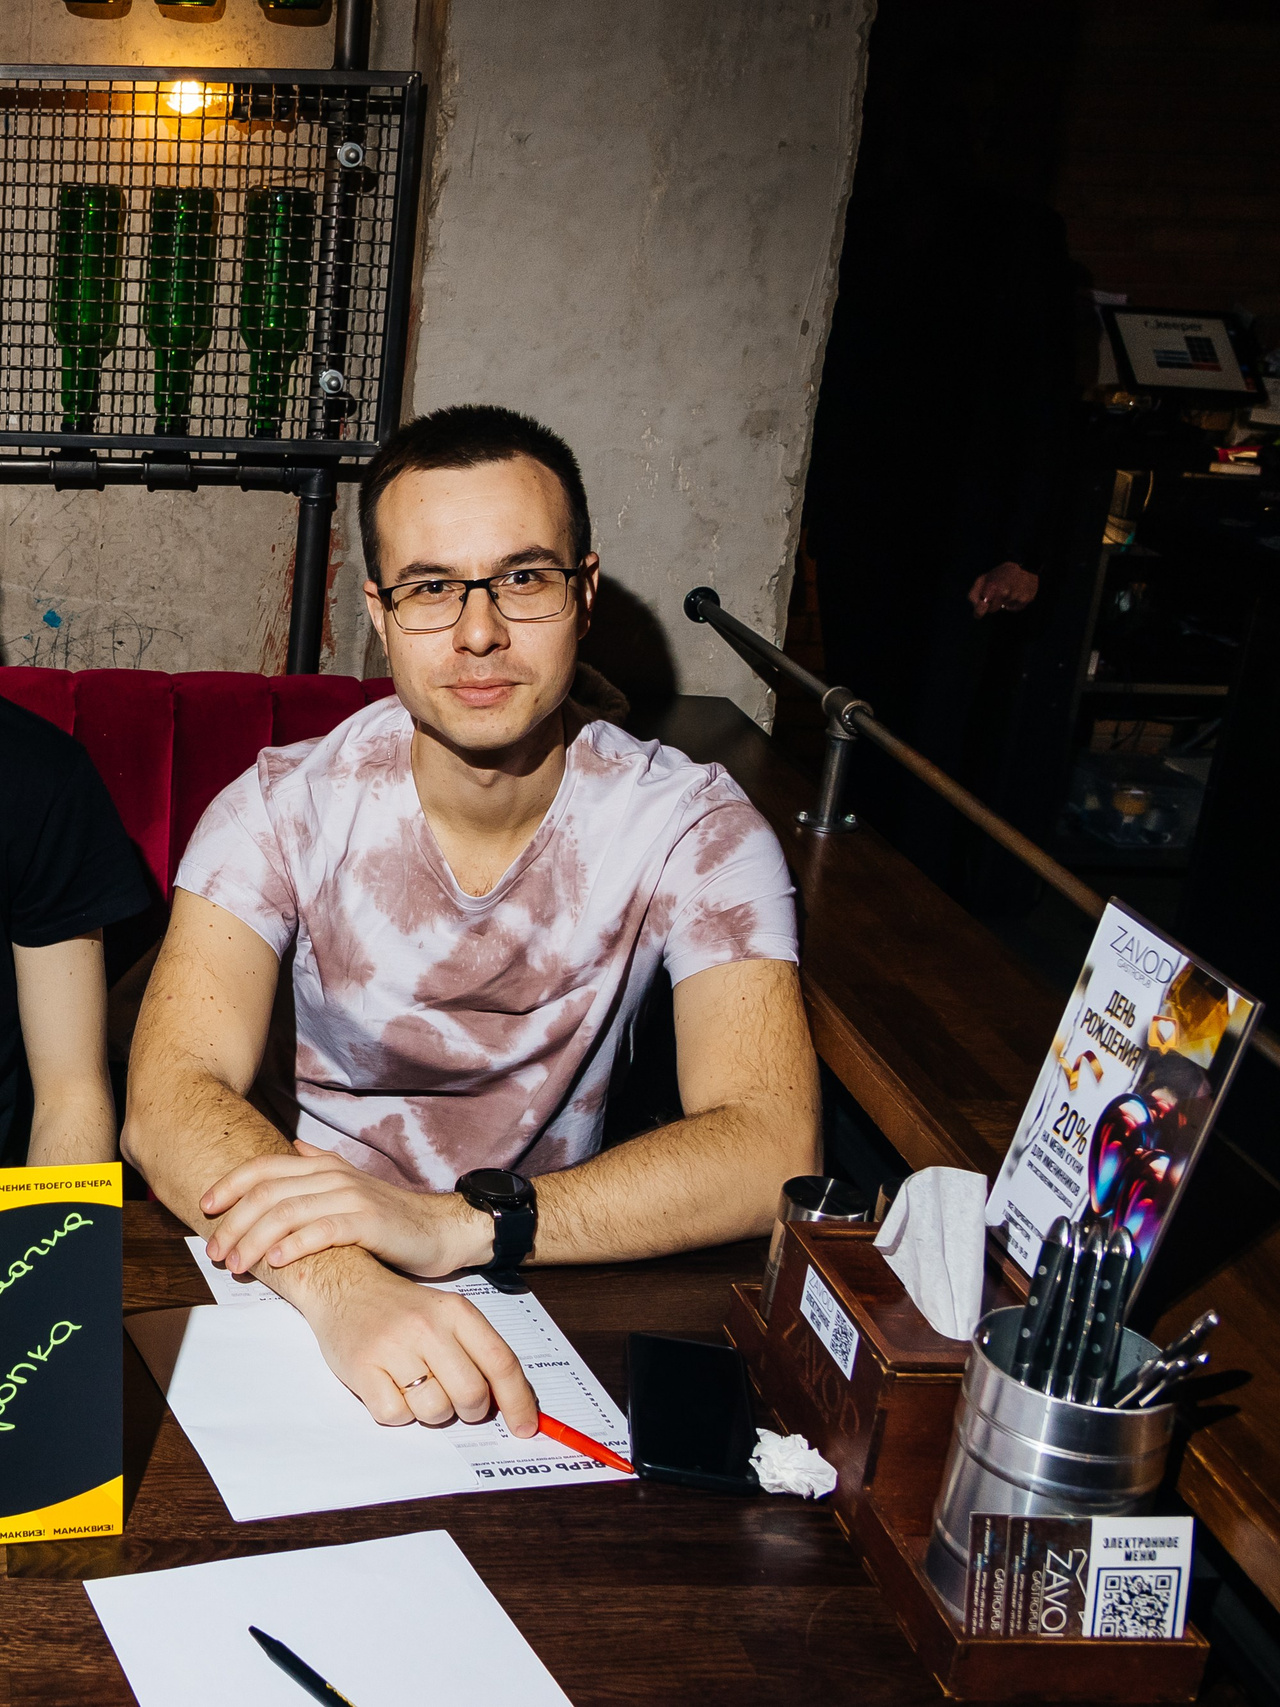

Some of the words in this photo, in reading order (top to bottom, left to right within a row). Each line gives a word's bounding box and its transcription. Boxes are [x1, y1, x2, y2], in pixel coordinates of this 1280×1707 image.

[1110, 926, 1175, 984] ZAVOD
[1104, 990, 1136, 1029] ДЕНЬ
[1080, 1008, 1142, 1071] РОЖДЕНИЯ
[1053, 1102, 1092, 1157] 20%
[33, 1180, 73, 1191] ТВОЕГО
[74, 1179, 113, 1189] ВЕЧЕРА
[498, 1465, 551, 1477] СВОИ
[53, 1524, 114, 1535] МАМАКВИЗ!
[1103, 1536, 1179, 1549] ЭЛЕКТРОННОЕ
[1124, 1551, 1157, 1561] МЕНЮ
[991, 1568, 1005, 1630] GASTROPUB
[1028, 1570, 1042, 1632] GASTROPUB
